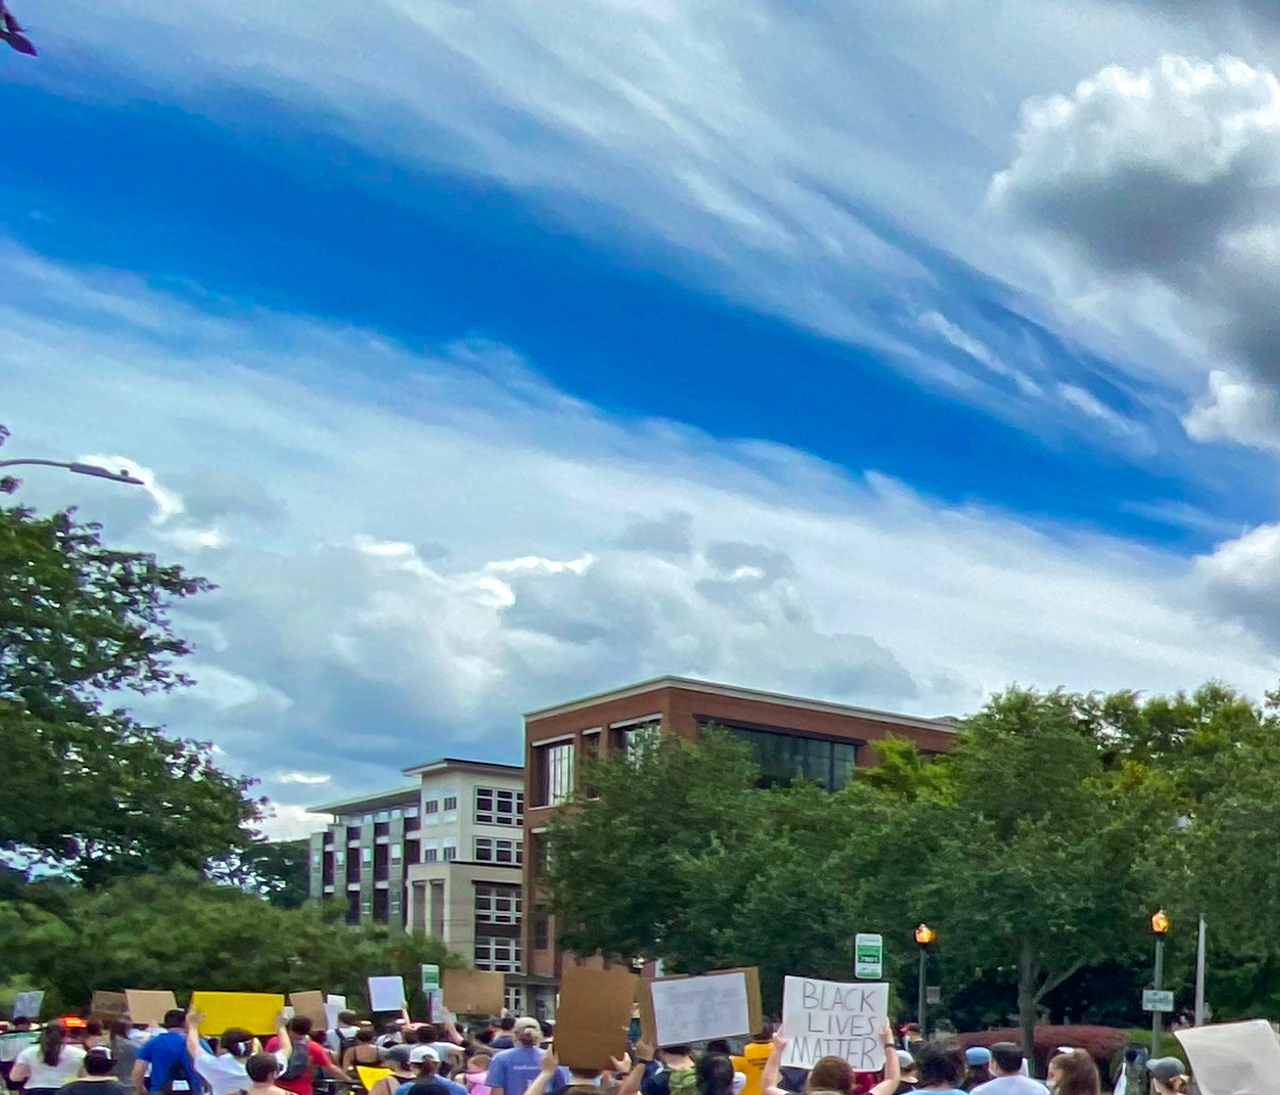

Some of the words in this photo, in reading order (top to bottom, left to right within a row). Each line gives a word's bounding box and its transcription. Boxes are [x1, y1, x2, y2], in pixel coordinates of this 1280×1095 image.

[803, 981, 876, 1012] BLACK
[808, 1011, 877, 1037] LIVES
[791, 1036, 877, 1069] MATTER
